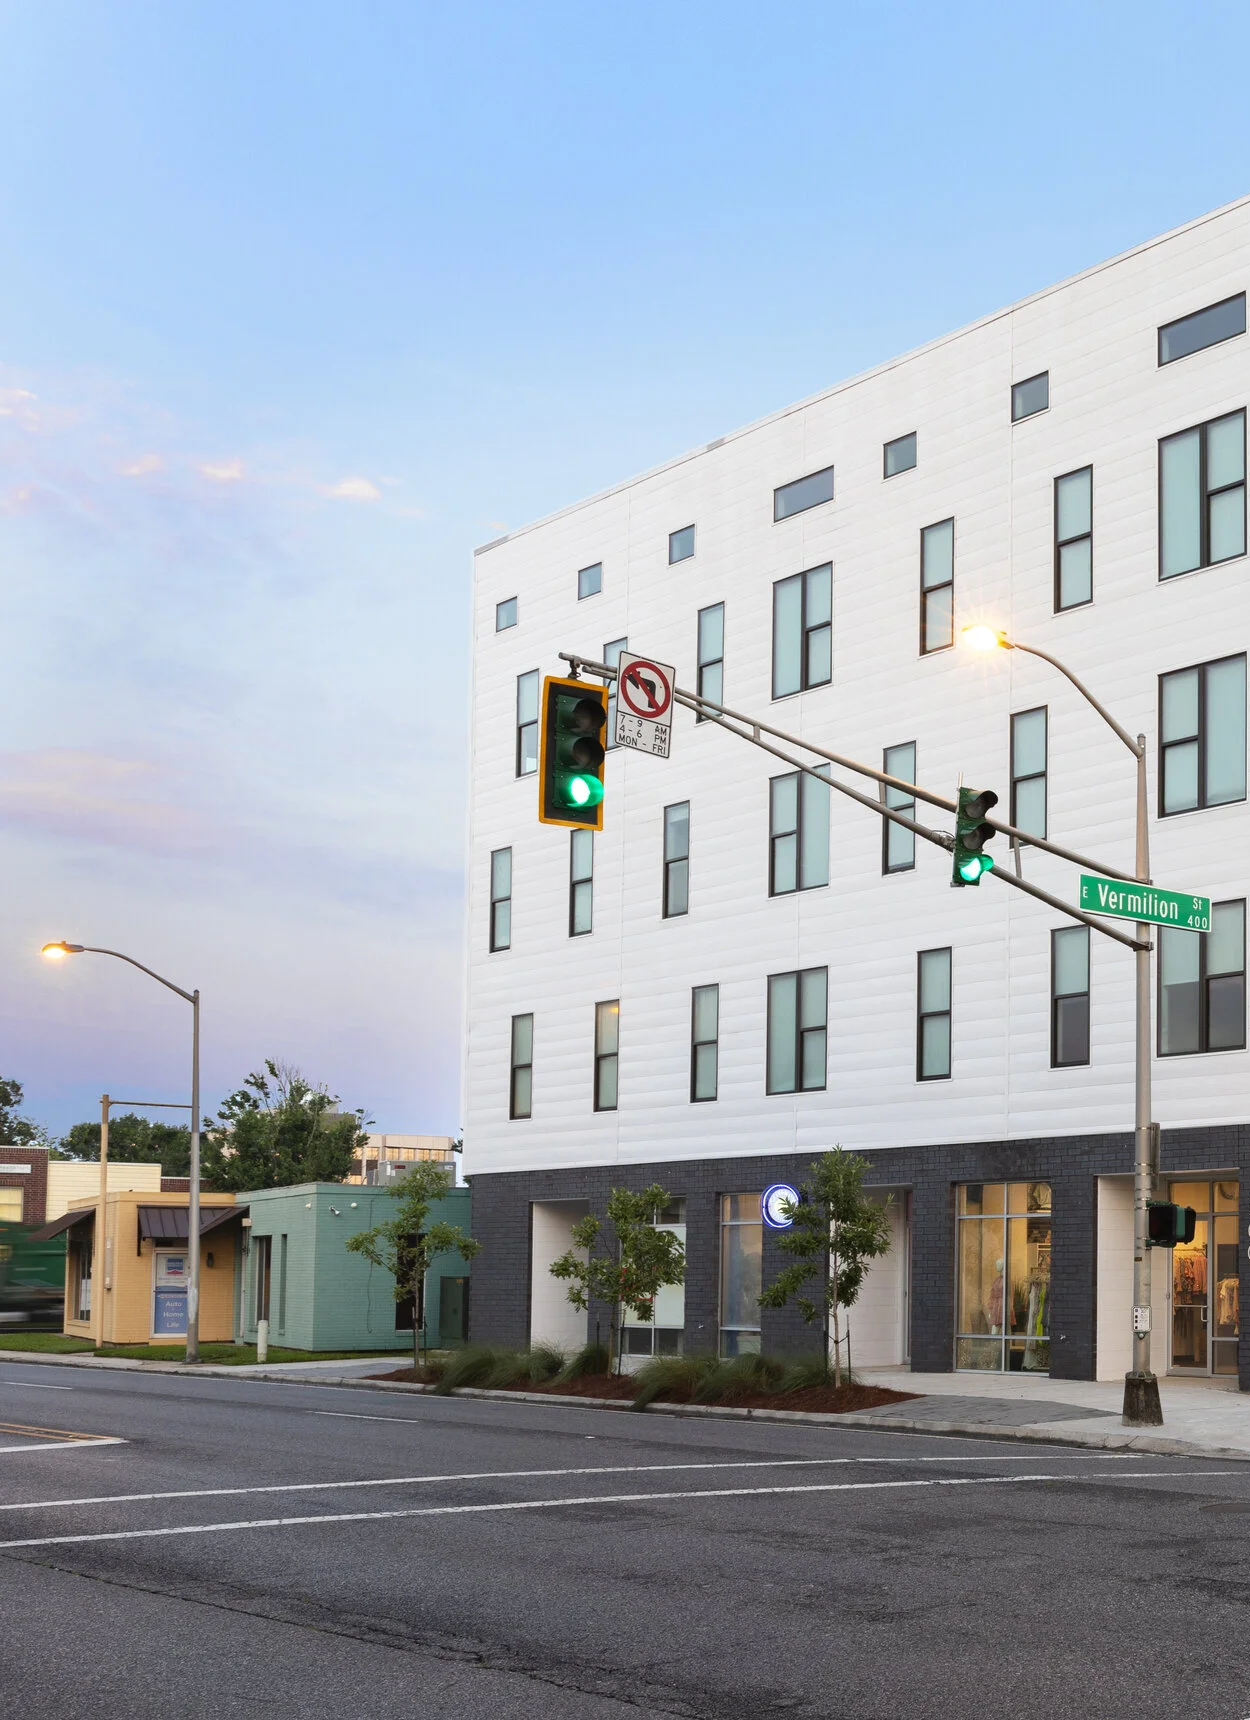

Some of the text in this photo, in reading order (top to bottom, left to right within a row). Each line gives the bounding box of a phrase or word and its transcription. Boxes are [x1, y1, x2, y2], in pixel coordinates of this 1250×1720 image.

[619, 724, 626, 733] 4
[636, 729, 643, 738] 6
[654, 735, 667, 745] PM
[620, 714, 626, 724] 7
[637, 719, 643, 728] 9
[654, 725, 667, 736] AM
[618, 734, 638, 747] MON
[652, 745, 666, 755] FRI
[1082, 883, 1203, 920] E Vermilion St
[1187, 915, 1208, 929] 400
